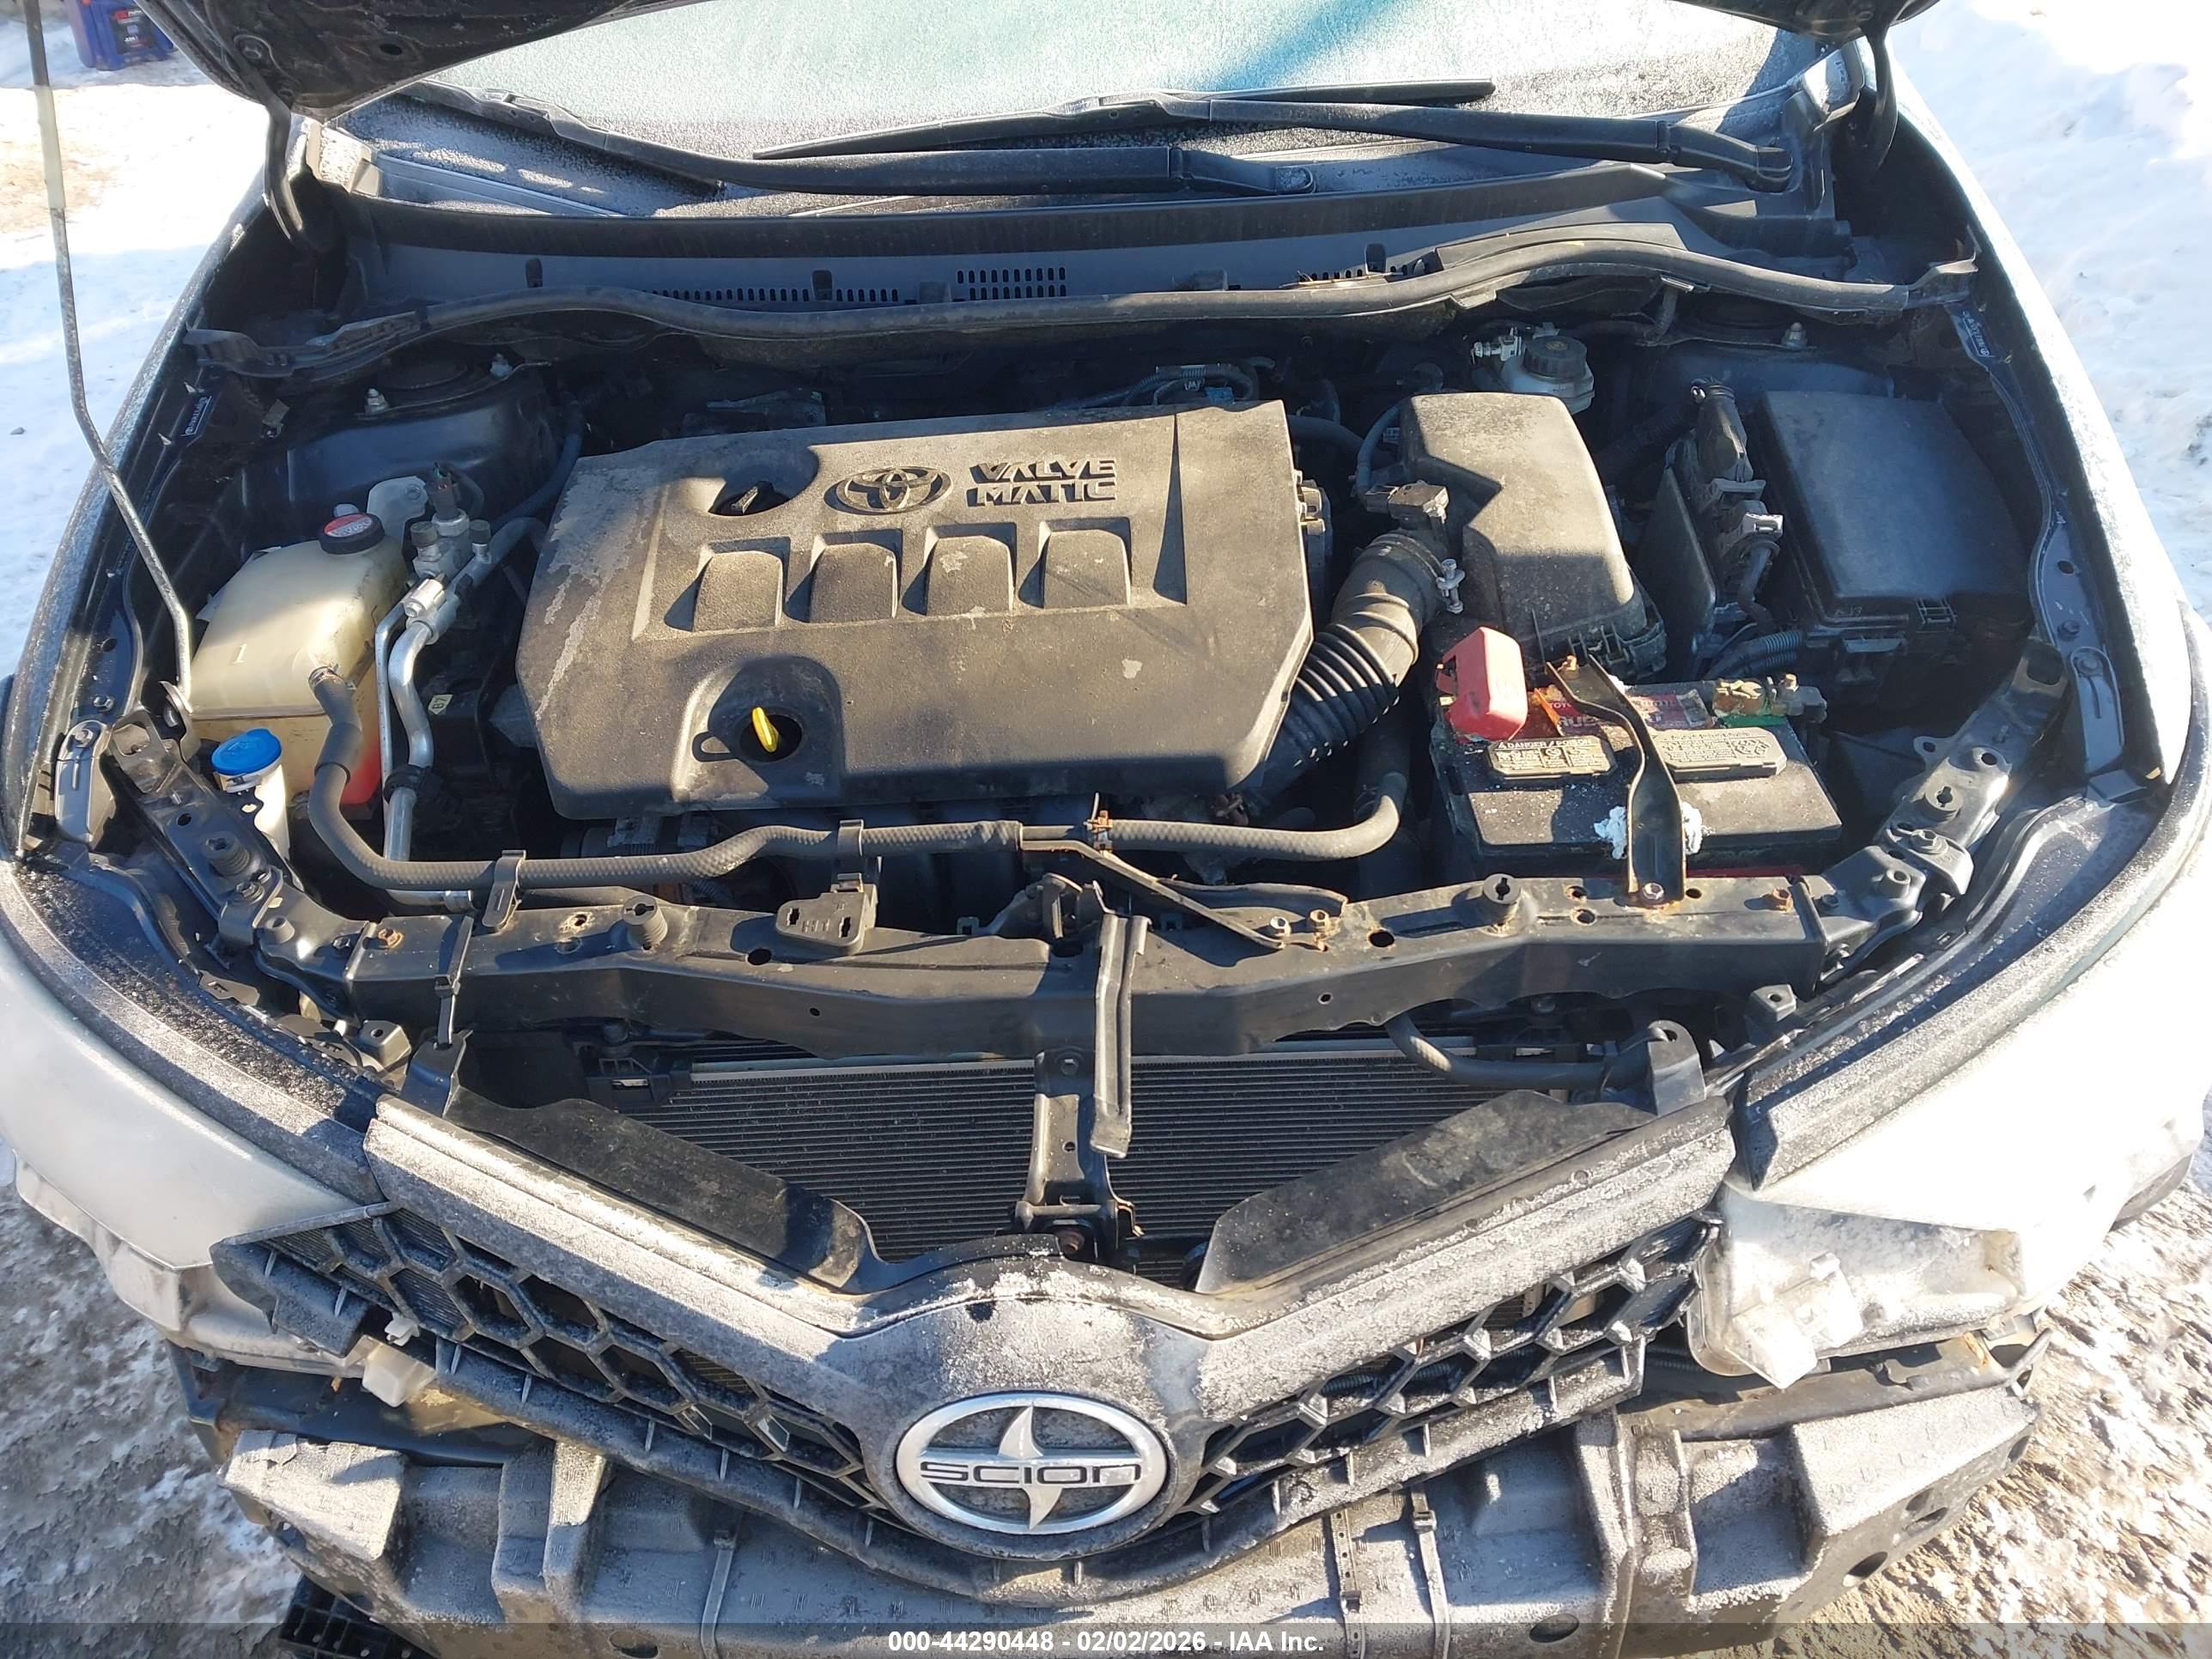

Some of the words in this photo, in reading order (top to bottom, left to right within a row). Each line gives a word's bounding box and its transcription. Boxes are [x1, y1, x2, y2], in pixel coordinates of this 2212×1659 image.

[971, 459, 1115, 483] VALVE
[968, 478, 1115, 507] MATIC
[920, 1461, 1141, 1485] SCION
